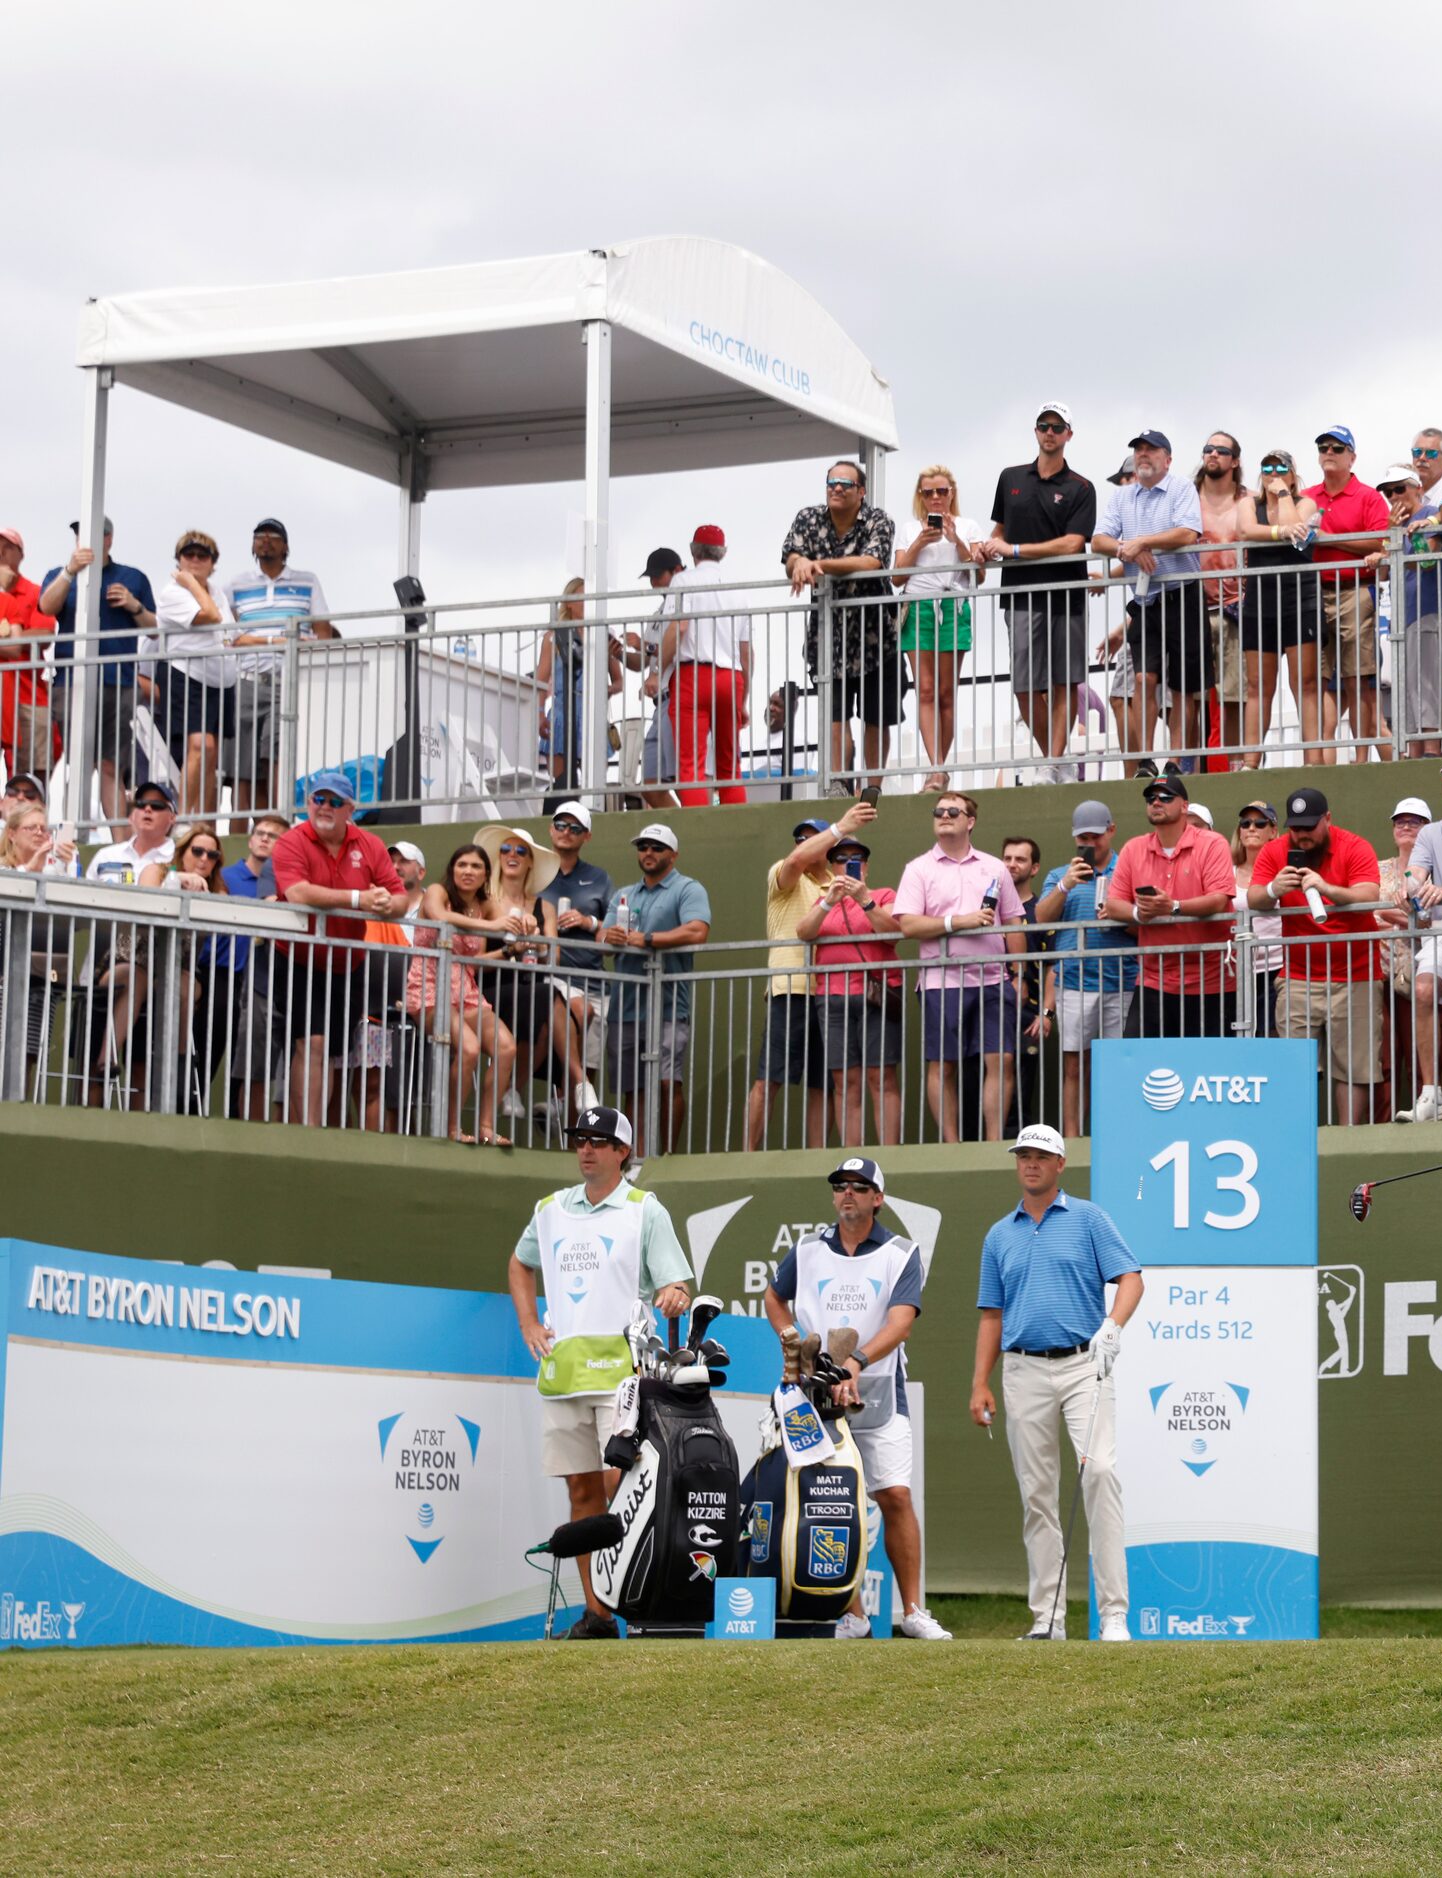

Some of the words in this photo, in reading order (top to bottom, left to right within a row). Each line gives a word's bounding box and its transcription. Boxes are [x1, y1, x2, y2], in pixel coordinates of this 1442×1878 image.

[689, 320, 768, 376] CHOCTAW
[772, 359, 810, 396] CLUB
[1189, 1076, 1268, 1103] AT&T
[1149, 1139, 1261, 1230] 13
[570, 1242, 591, 1251] AT&T
[562, 1251, 597, 1262] BYRON
[560, 1261, 600, 1272] NELSON
[839, 1284, 860, 1293] AT&T
[830, 1293, 866, 1302] BYRON
[1168, 1286, 1208, 1305] Par
[1215, 1286, 1230, 1305] 4
[27, 1265, 86, 1316] AT&T
[87, 1275, 175, 1328] BYRON
[179, 1287, 301, 1339] NELSON
[826, 1302, 868, 1311] NELSON
[1147, 1320, 1211, 1339] Yards
[1217, 1321, 1253, 1339] 512
[1183, 1392, 1215, 1403] AT&T
[1172, 1405, 1226, 1417] BYRON
[1168, 1419, 1231, 1431] NELSON
[413, 1429, 446, 1446] AT&T
[791, 1431, 821, 1451] RBC
[401, 1449, 456, 1469] BYRON
[395, 1471, 460, 1491] NELSON
[816, 1475, 843, 1485] MATT
[809, 1486, 850, 1496] KUCHAR
[688, 1491, 727, 1504] PATTON
[687, 1507, 726, 1519] KIZZIRE
[810, 1506, 846, 1515] TROON
[813, 1562, 843, 1575] RBC
[13, 1601, 62, 1640] FedEx
[1167, 1615, 1228, 1635] FedEx
[725, 1621, 757, 1633] AT&T
